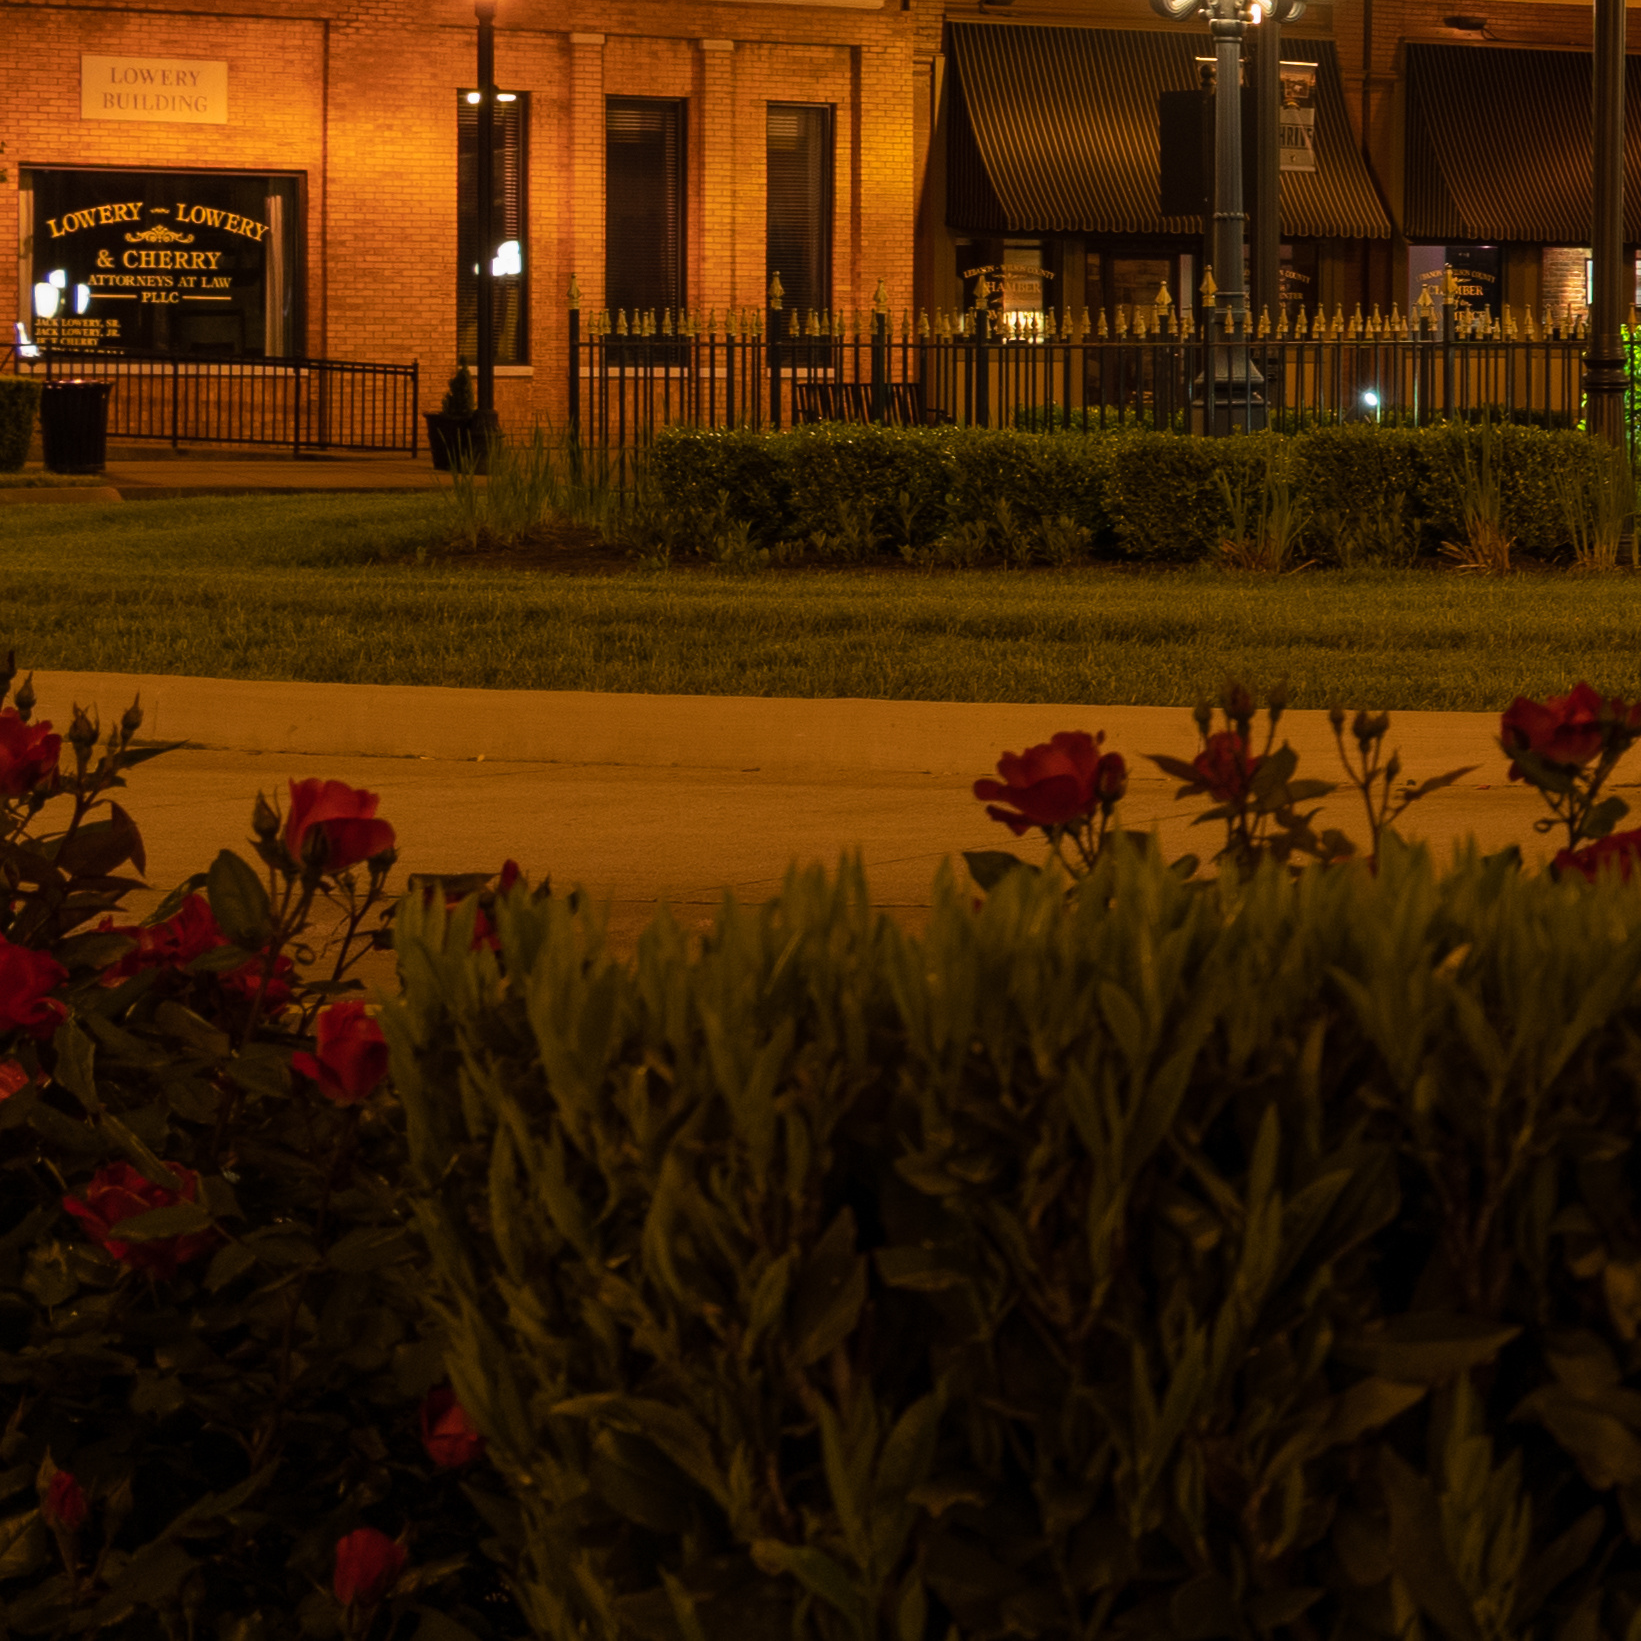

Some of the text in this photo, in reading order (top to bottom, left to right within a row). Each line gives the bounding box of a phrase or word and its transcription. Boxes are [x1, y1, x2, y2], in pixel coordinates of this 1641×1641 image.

[111, 67, 200, 87] LOWERY
[103, 92, 207, 113] BUILDING
[46, 202, 269, 241] LOWERY LOWERY
[97, 249, 222, 270] & CHERRY
[88, 274, 233, 289] ATTORNEYS AT LAW
[142, 292, 180, 304] PLLC
